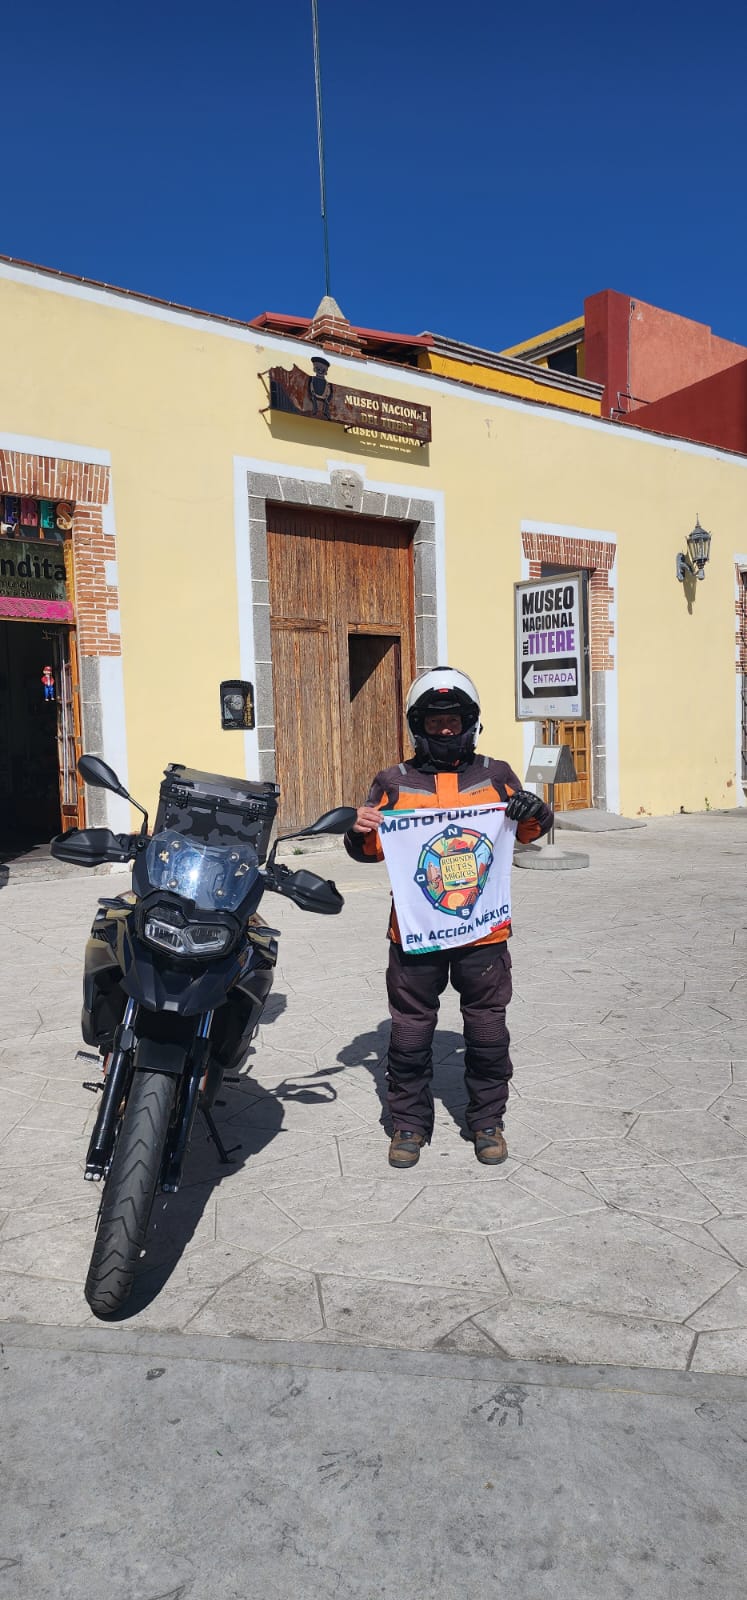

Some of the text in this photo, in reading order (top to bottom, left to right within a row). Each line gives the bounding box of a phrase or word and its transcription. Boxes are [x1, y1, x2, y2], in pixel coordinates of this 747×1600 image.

[345, 394, 428, 422] MUSEO NACIONAL
[360, 412, 378, 426] DEL
[1, 554, 67, 581] ndita
[522, 586, 574, 615] MUSEO
[522, 612, 574, 633] NACIONAL
[528, 629, 575, 655] TÍTERE
[533, 672, 574, 684] ENTRADA
[447, 827, 458, 836] N
[461, 908, 470, 916] S
[406, 933, 423, 945] EN
[428, 922, 474, 941] ACCIÓN
